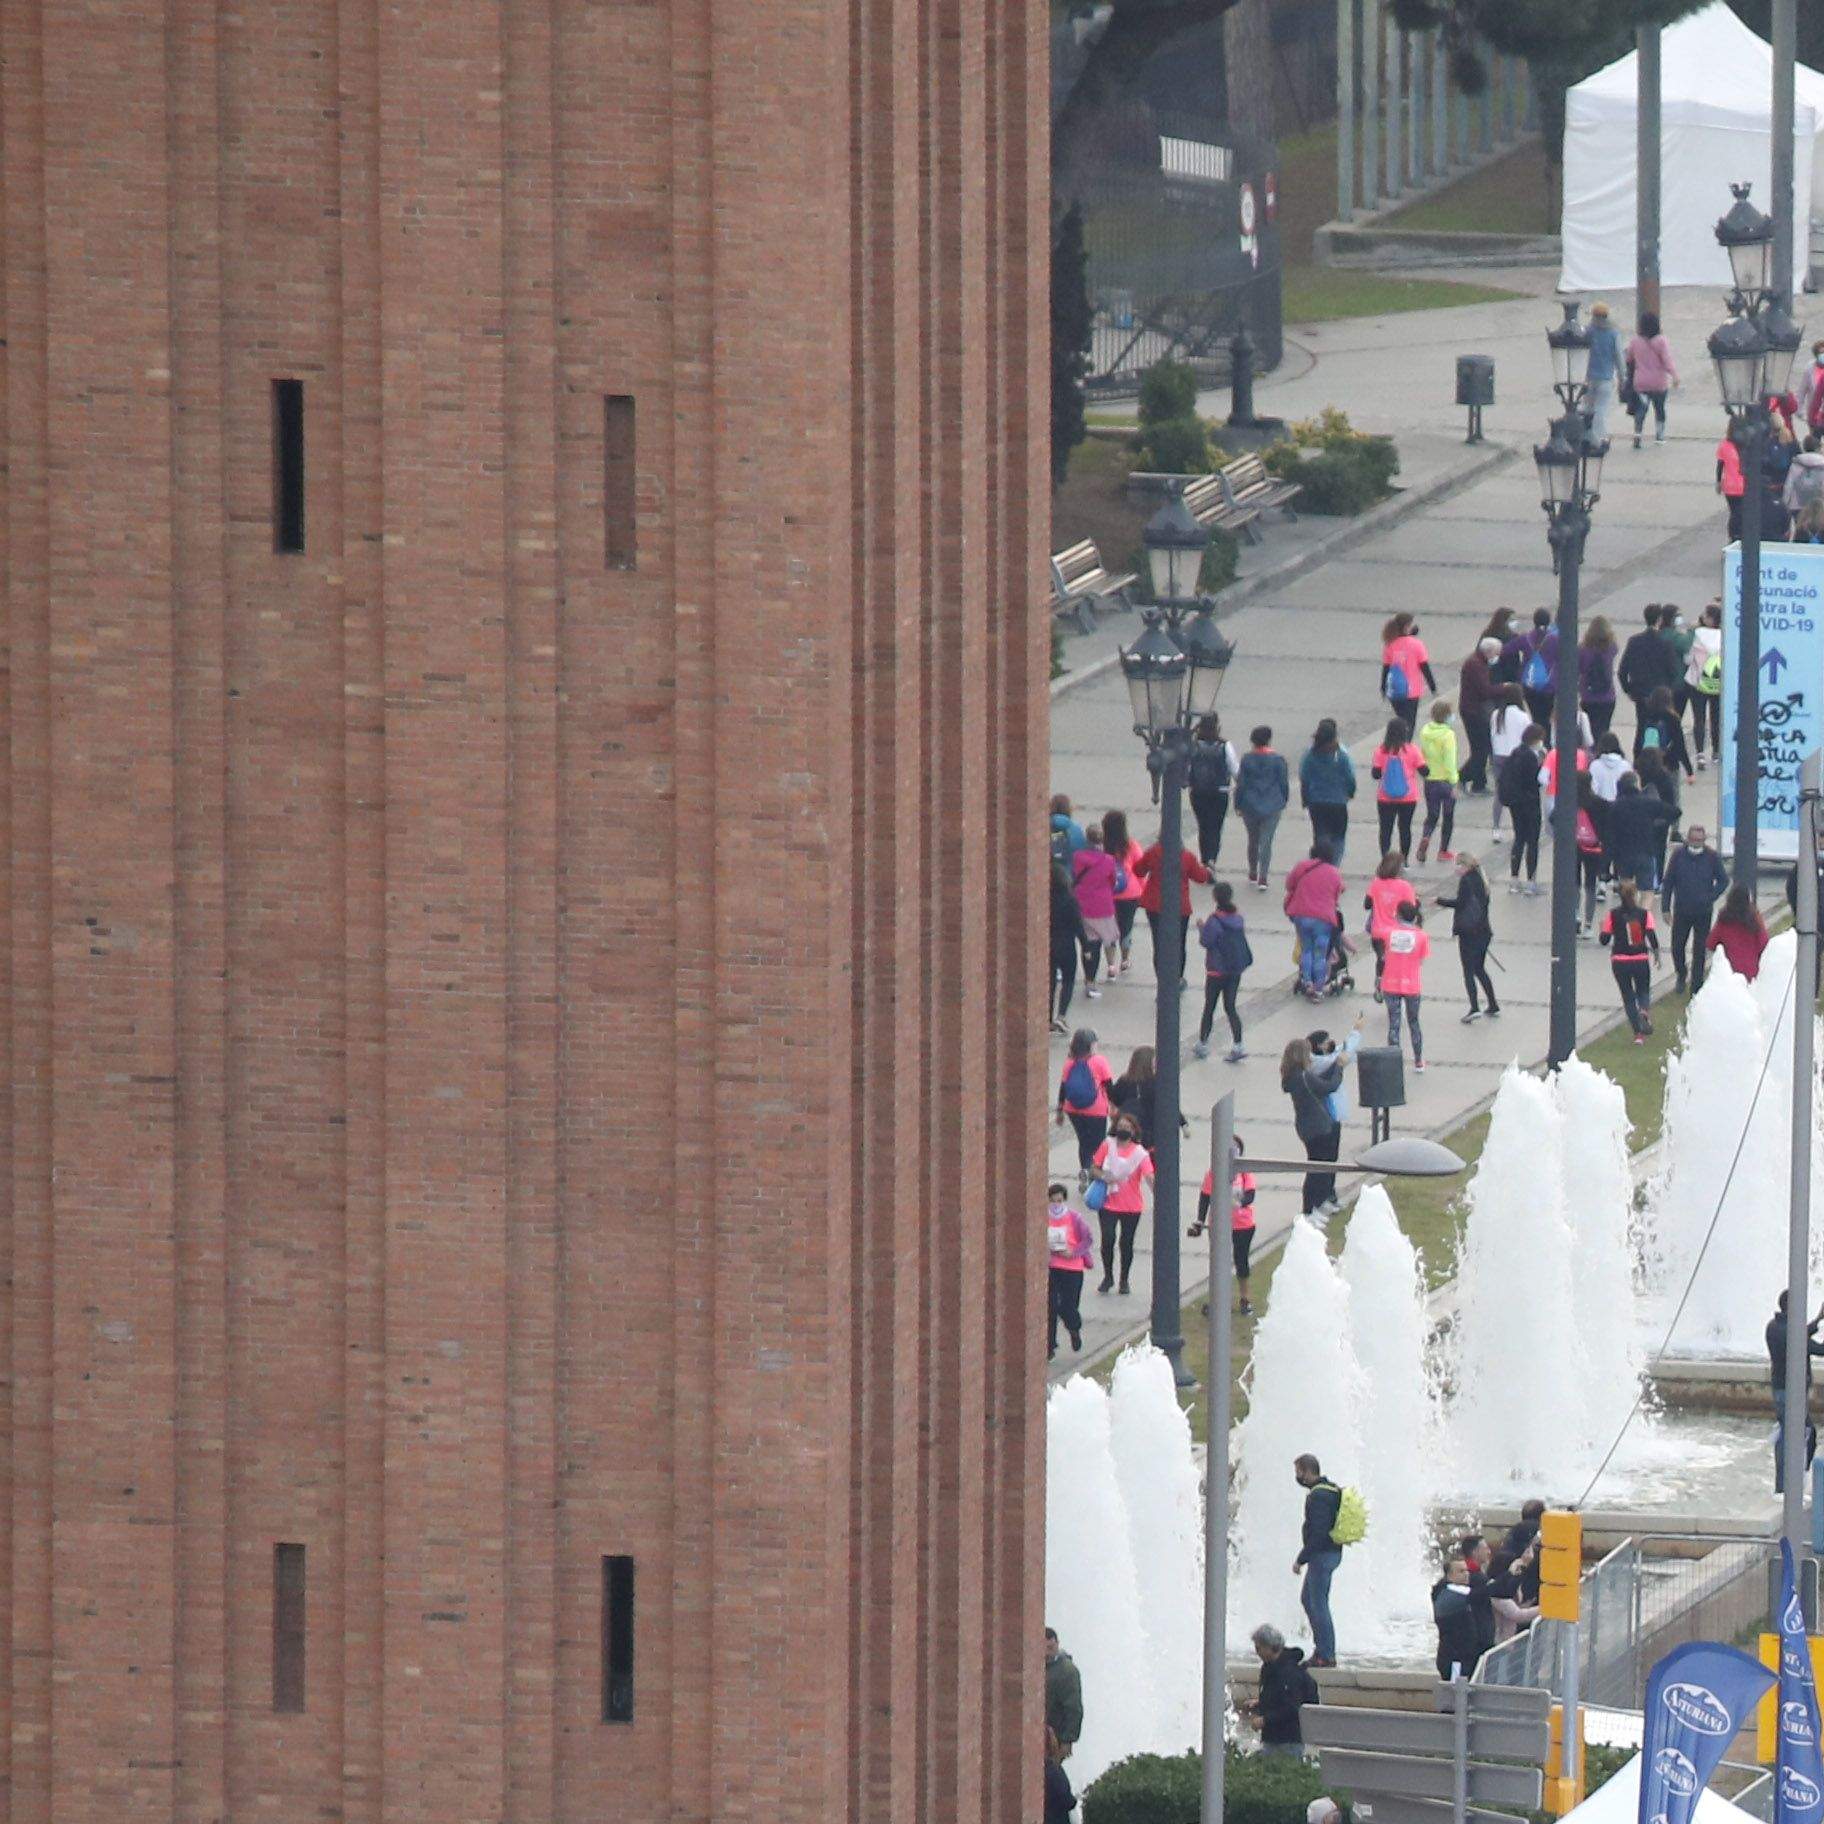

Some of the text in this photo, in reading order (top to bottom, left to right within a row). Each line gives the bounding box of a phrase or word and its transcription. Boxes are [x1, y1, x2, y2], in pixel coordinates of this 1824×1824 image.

[1736, 566, 1797, 581] Pnt de
[1735, 603, 1786, 615] ctra
[1735, 615, 1814, 632] CVID-19
